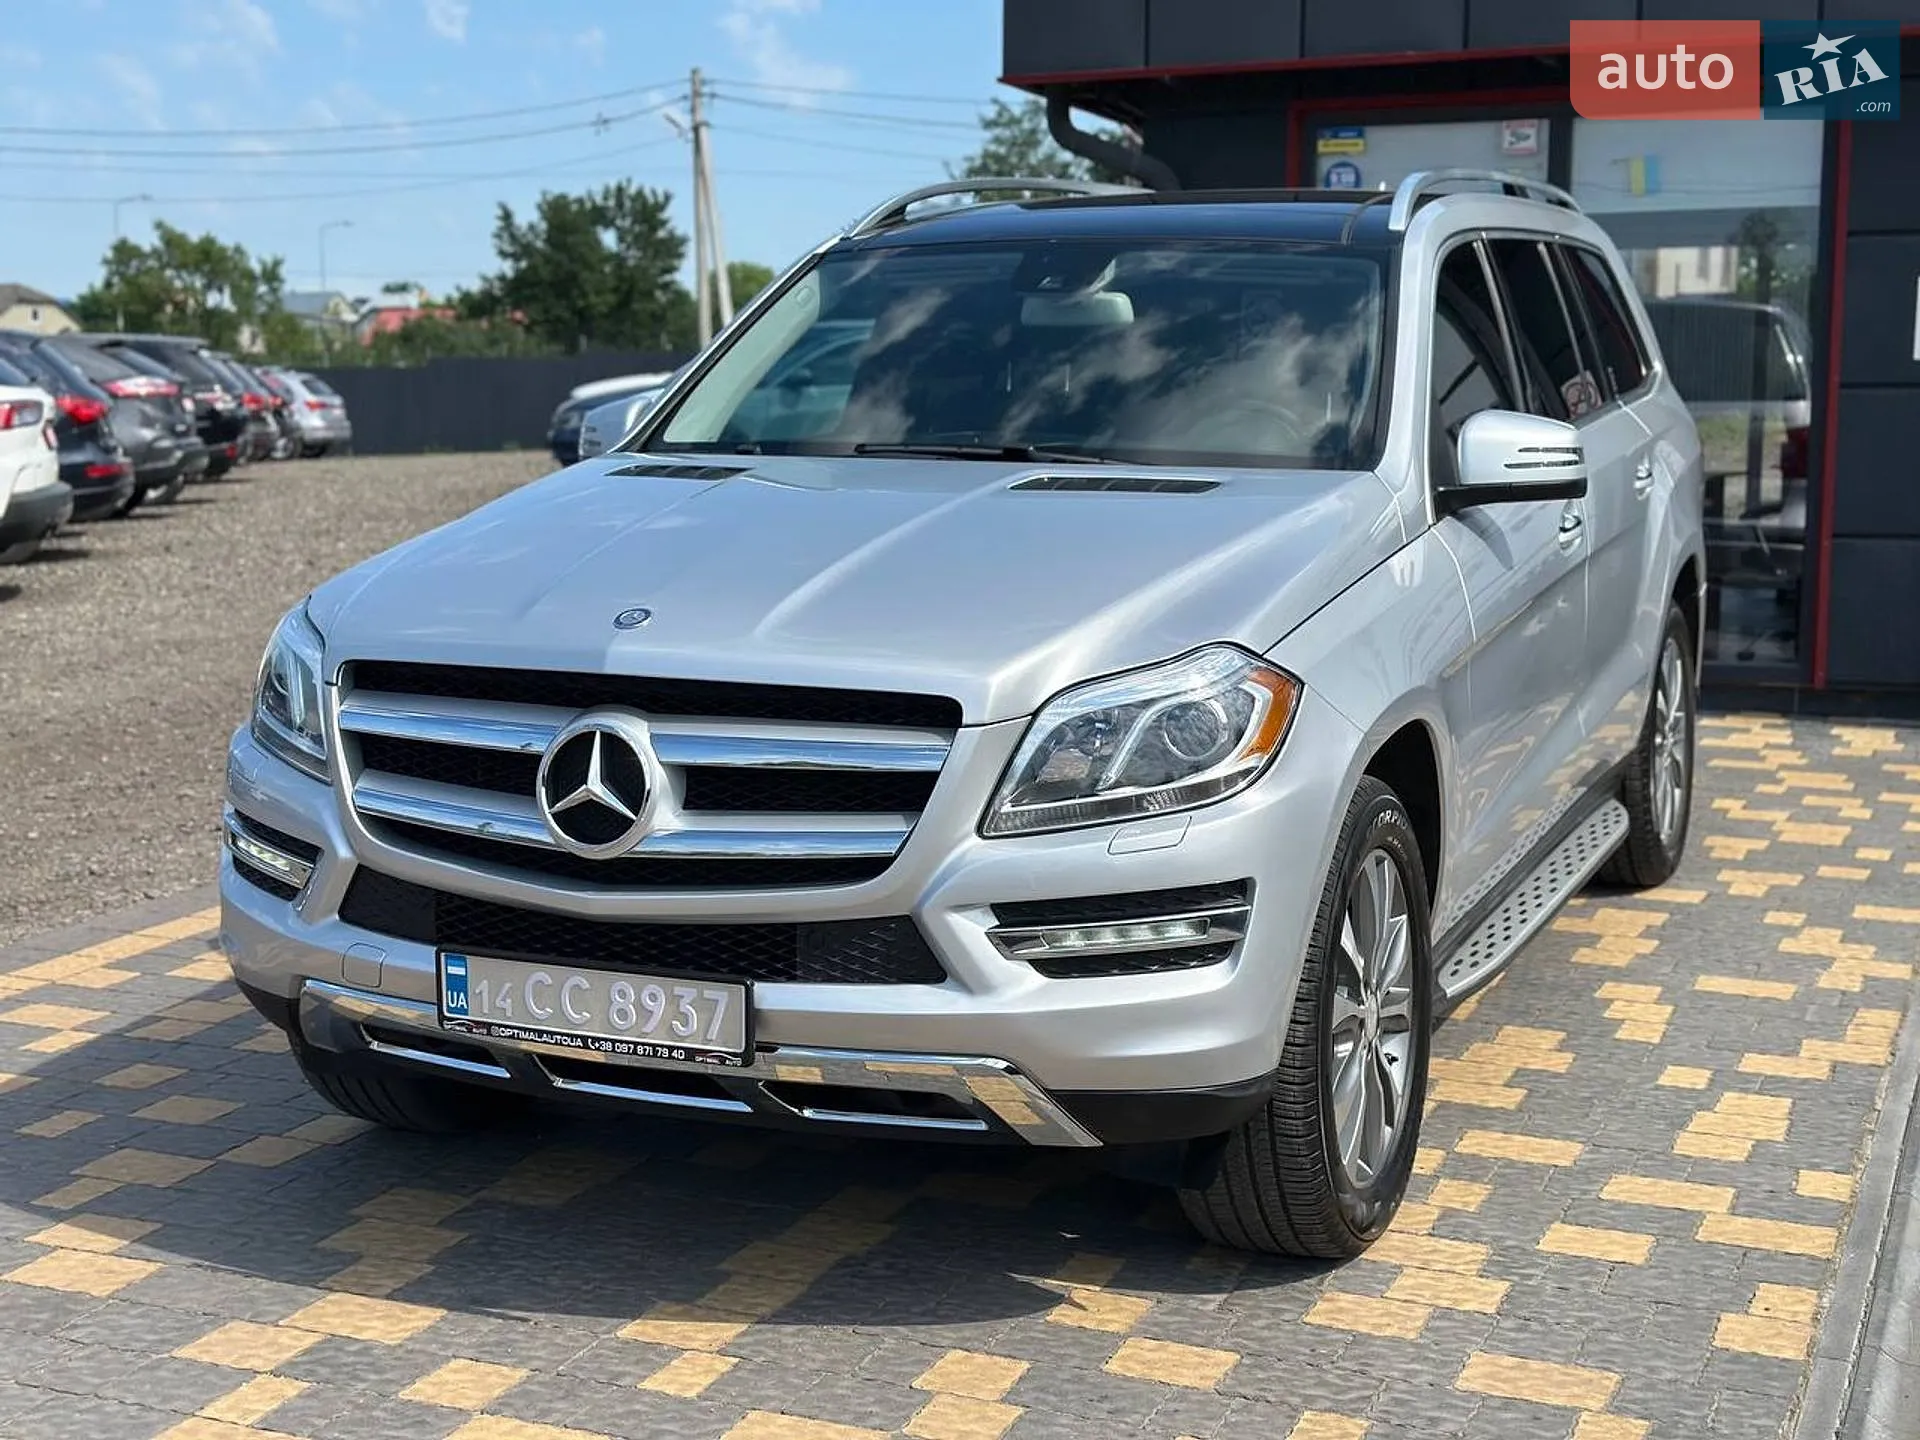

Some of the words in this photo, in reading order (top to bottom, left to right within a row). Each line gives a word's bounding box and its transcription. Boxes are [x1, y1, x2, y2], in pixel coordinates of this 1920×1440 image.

[448, 991, 467, 1009] UA
[475, 979, 513, 1018] 14
[525, 971, 591, 1024] CC
[609, 981, 728, 1041] 8937
[615, 1043, 633, 1053] 097
[637, 1045, 653, 1056] 871
[656, 1047, 669, 1057] 79
[671, 1049, 685, 1060] 40
